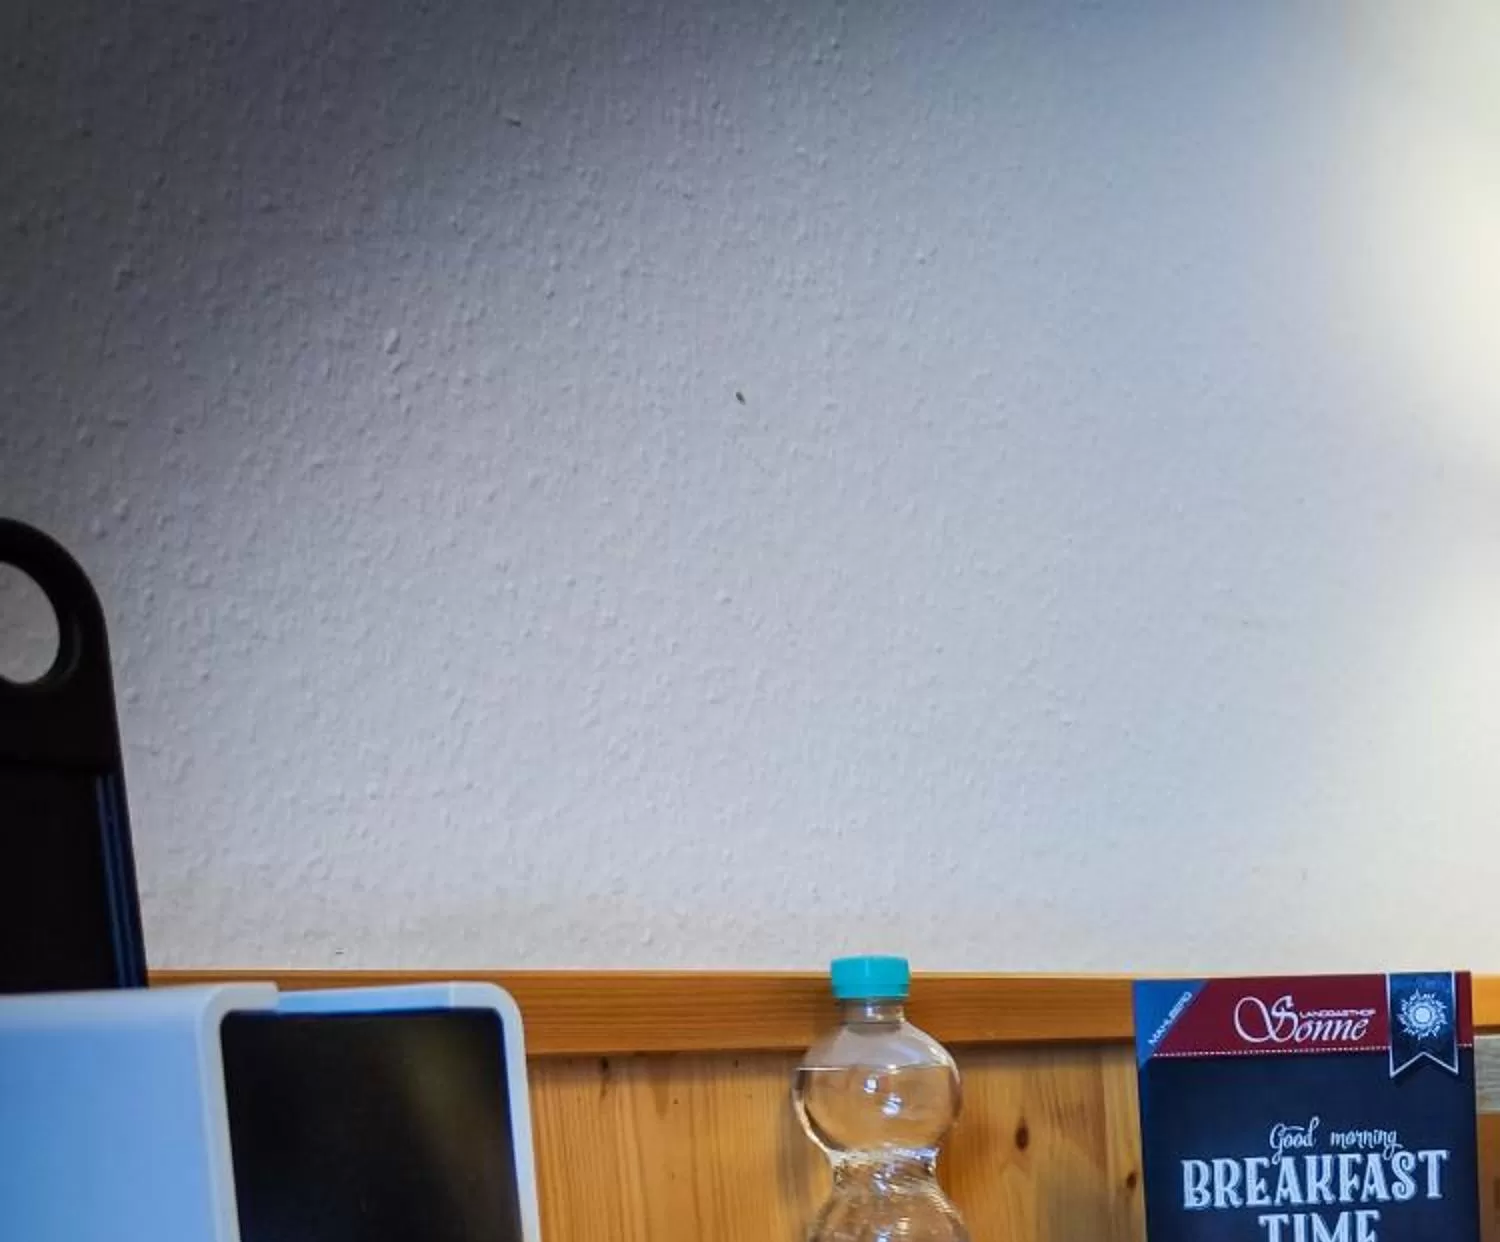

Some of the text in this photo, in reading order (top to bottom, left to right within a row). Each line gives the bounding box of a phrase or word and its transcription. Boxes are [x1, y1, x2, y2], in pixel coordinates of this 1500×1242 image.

[1234, 995, 1369, 1043] Sonne
[1269, 1115, 1404, 1165] Good morning
[1180, 1149, 1449, 1210] BREAKFAST
